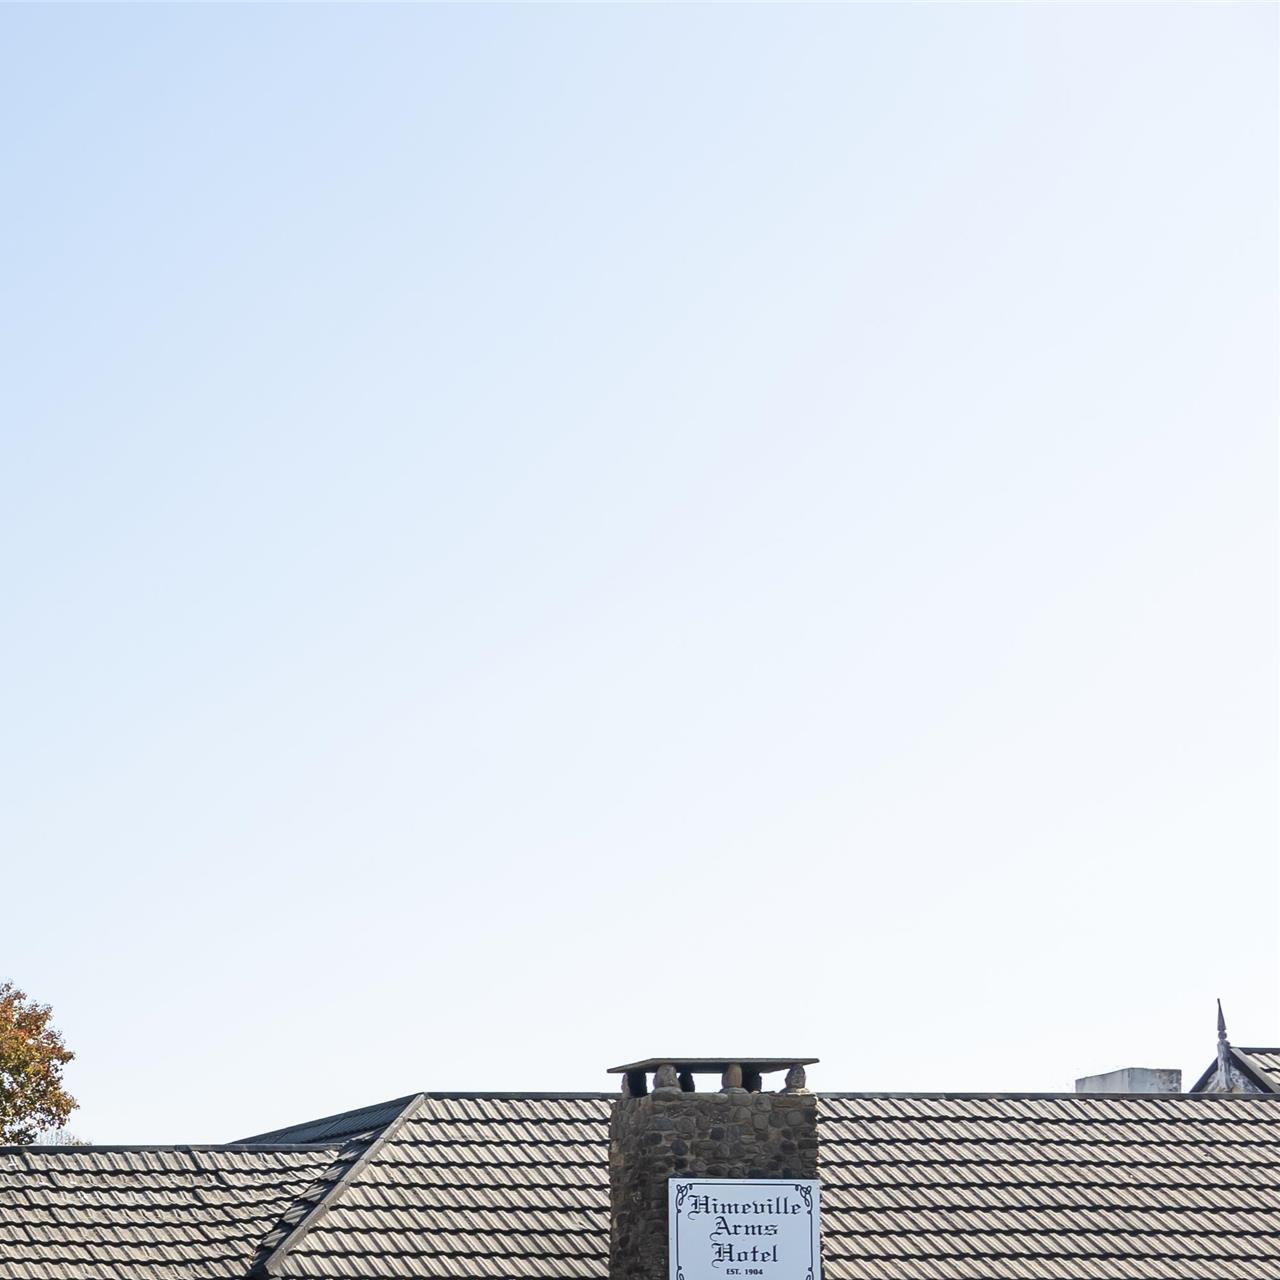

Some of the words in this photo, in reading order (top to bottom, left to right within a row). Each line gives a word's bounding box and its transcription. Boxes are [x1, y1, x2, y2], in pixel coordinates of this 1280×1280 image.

[688, 1195, 801, 1220] Himeville
[709, 1216, 778, 1242] Arms
[711, 1242, 778, 1268] Hotel
